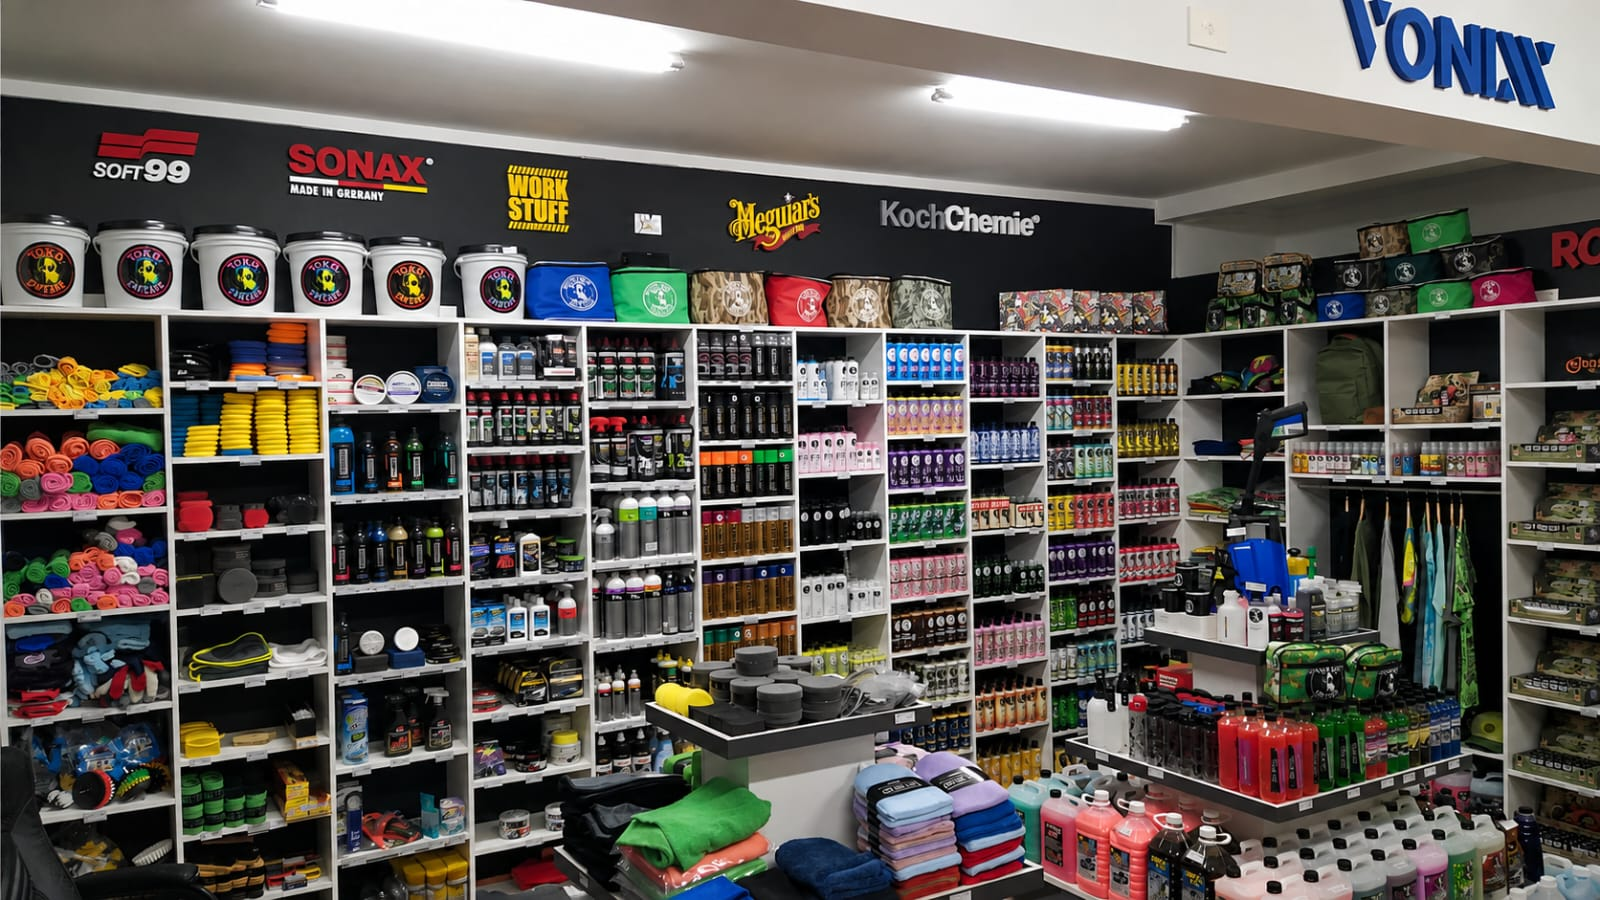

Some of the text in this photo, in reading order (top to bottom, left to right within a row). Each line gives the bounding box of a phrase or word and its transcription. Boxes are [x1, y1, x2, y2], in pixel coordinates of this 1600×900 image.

[288, 143, 427, 185] SONAX
[289, 183, 319, 196] MADE
[322, 186, 334, 198] IN
[507, 173, 569, 201] WORK
[508, 196, 569, 224] STUFF
